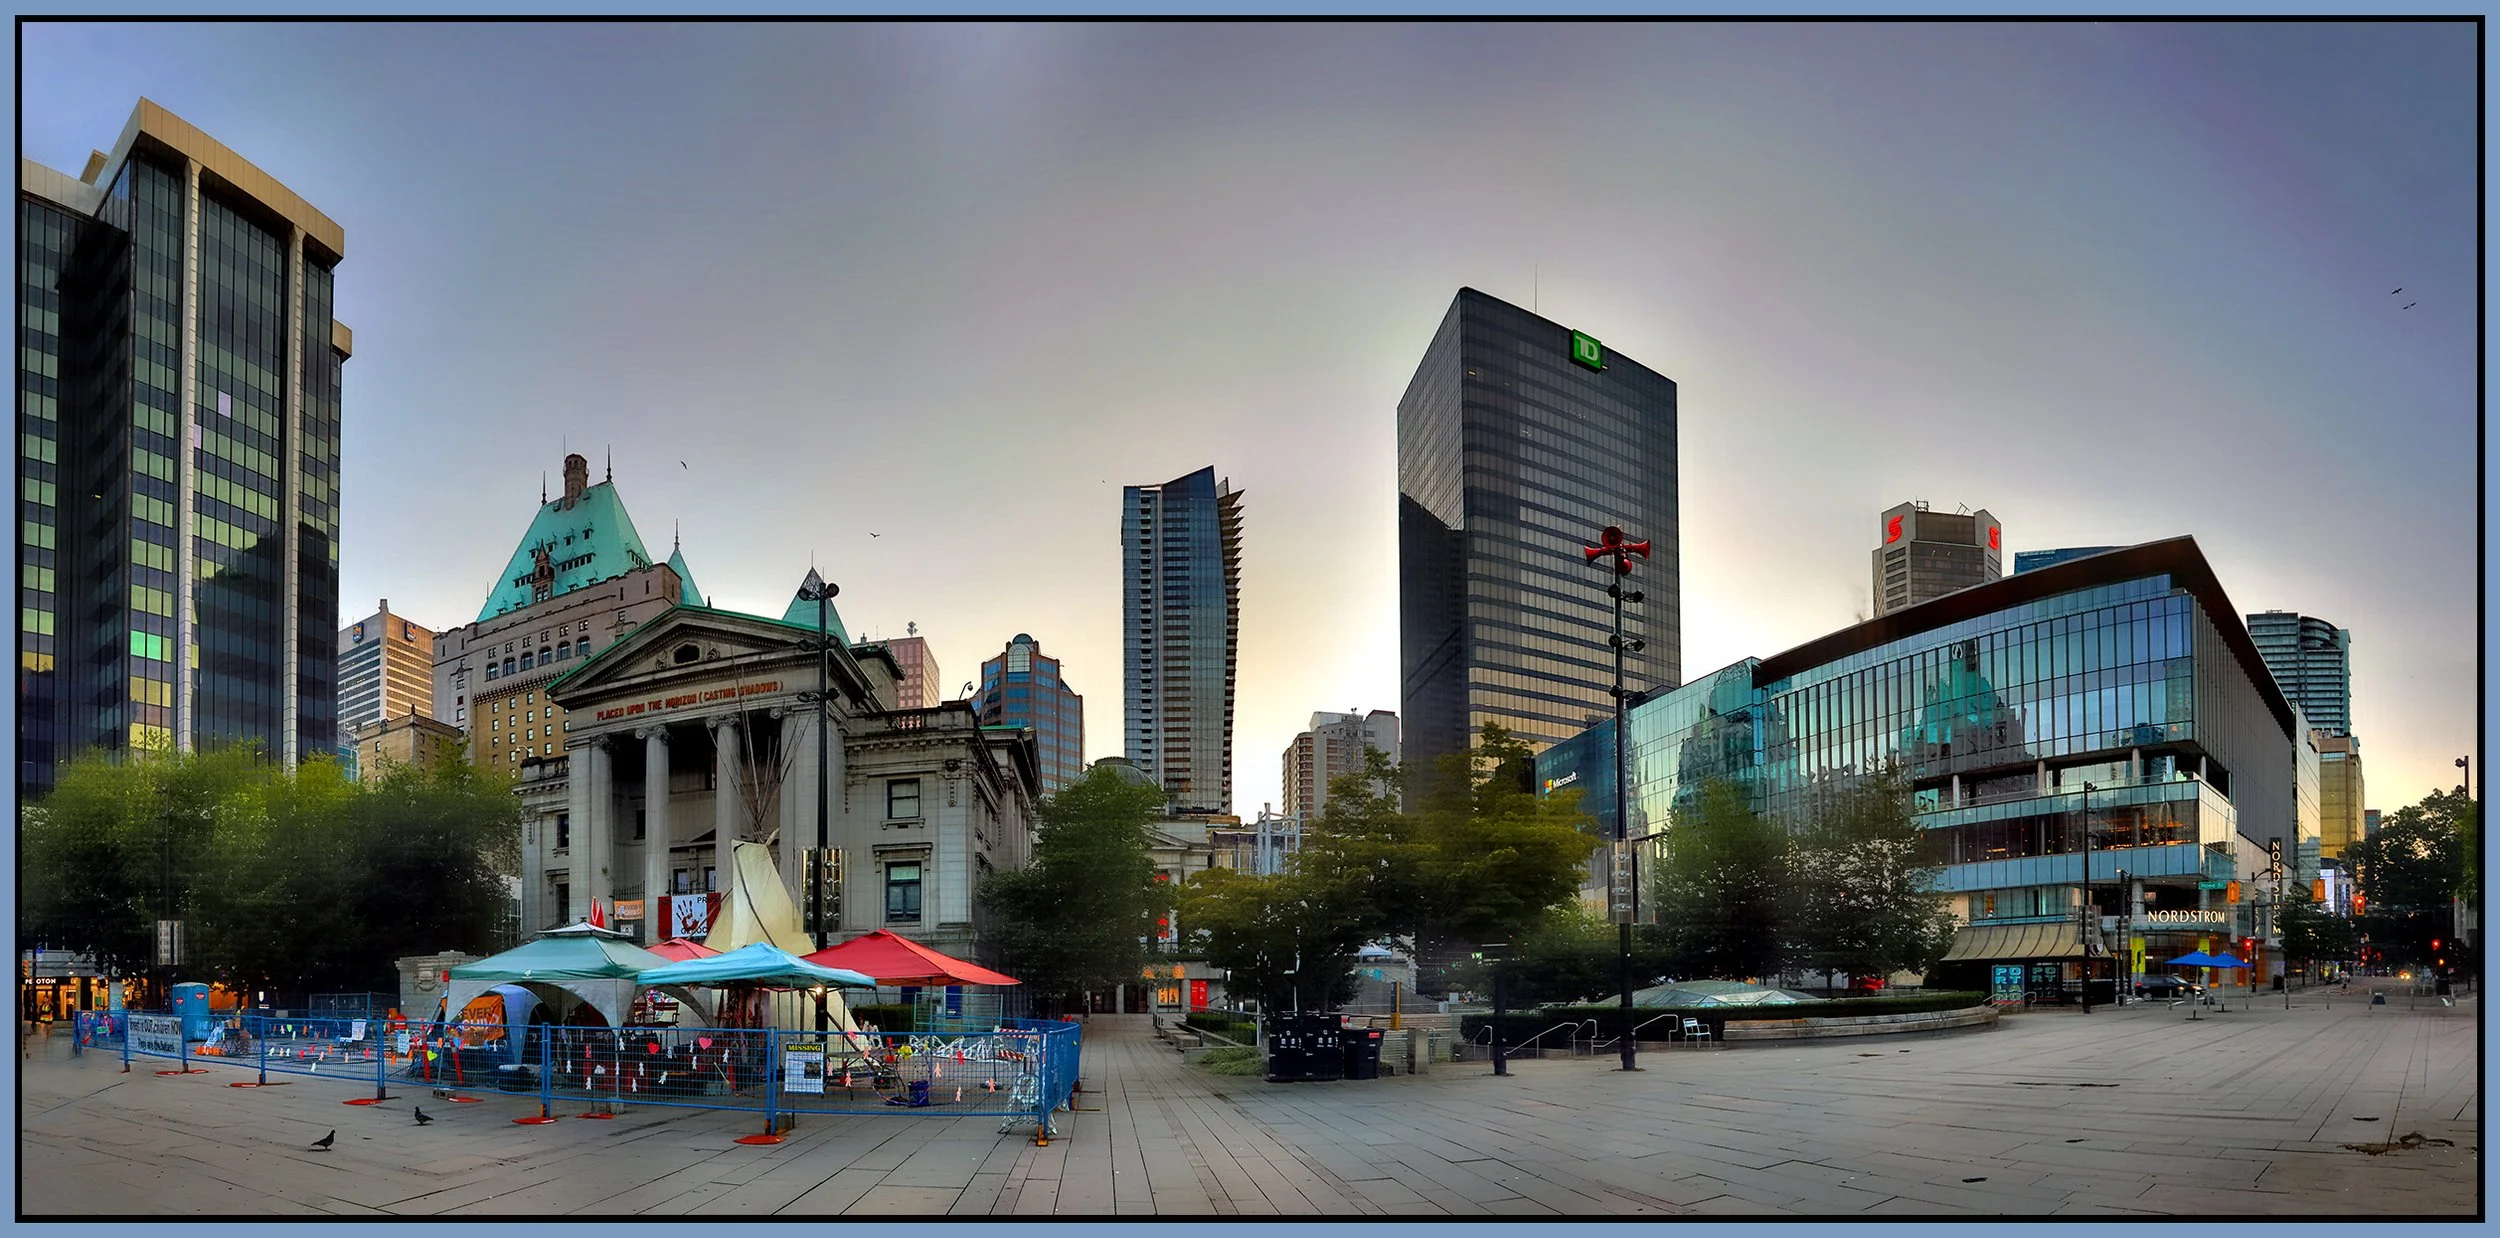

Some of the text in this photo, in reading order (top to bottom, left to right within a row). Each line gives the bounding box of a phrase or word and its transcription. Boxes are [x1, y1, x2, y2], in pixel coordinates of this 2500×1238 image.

[1575, 335, 1598, 361] TD
[597, 707, 624, 721] PLACED
[627, 703, 645, 716] UPON
[648, 699, 662, 711] THE
[666, 693, 697, 708] HORIZON
[1553, 771, 1577, 789] Microsoft
[2148, 910, 2225, 923] NORDSTROM
